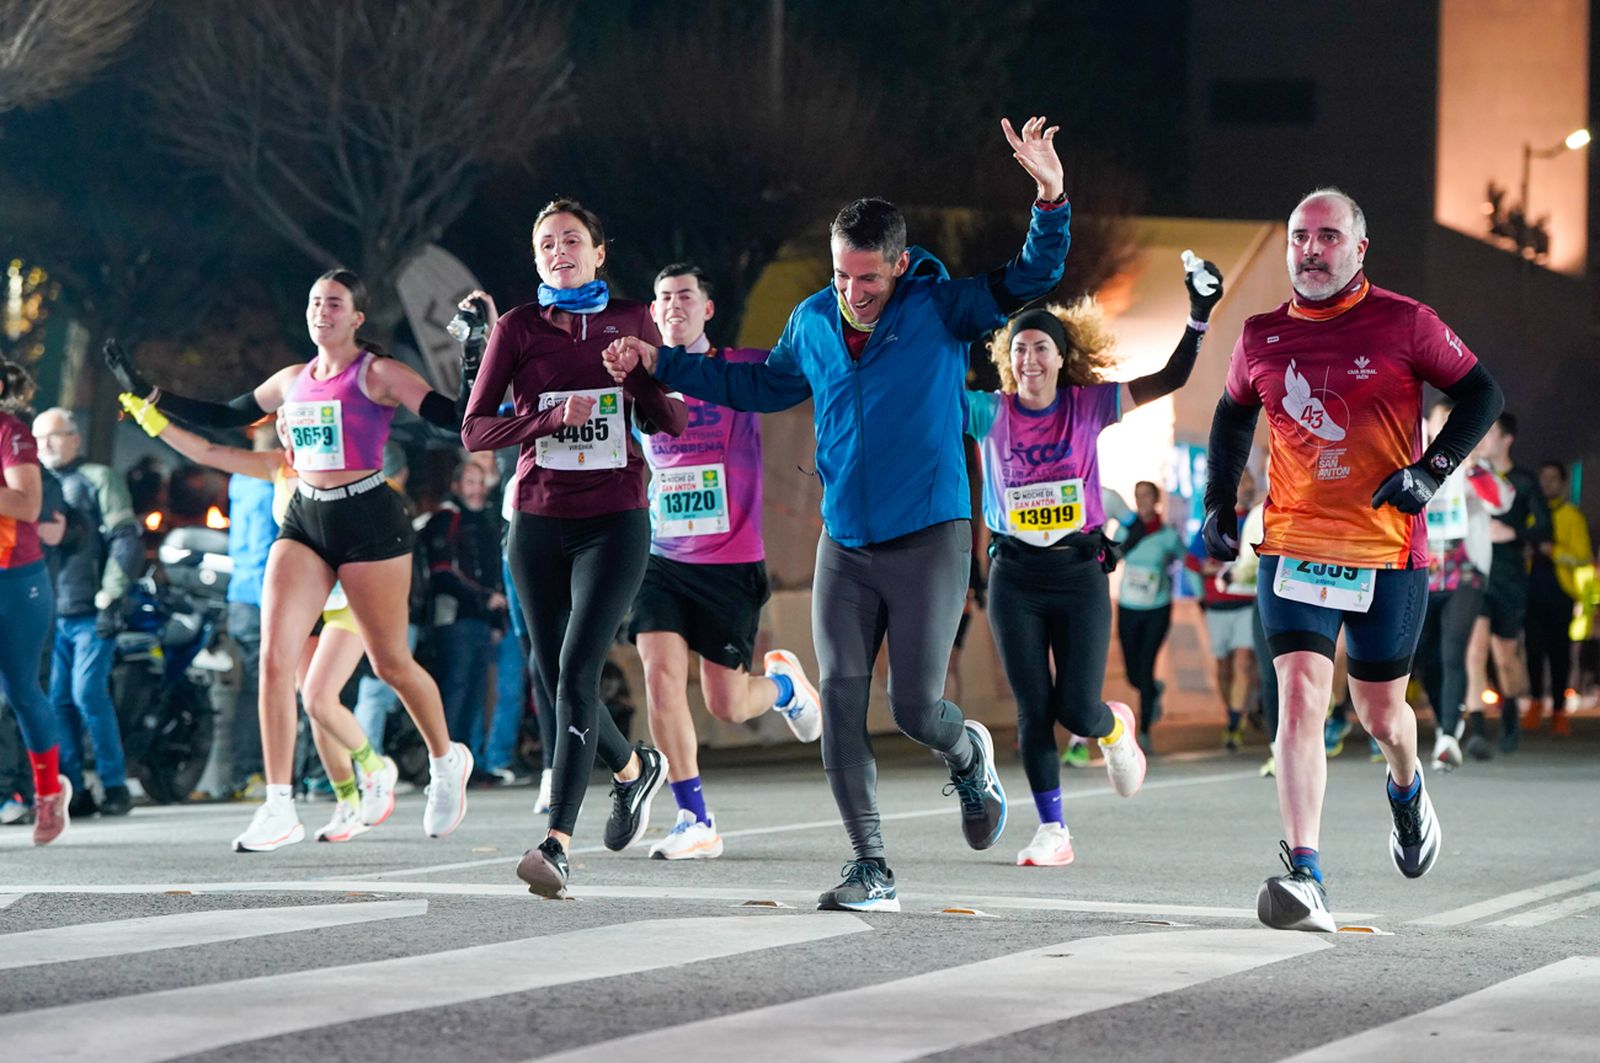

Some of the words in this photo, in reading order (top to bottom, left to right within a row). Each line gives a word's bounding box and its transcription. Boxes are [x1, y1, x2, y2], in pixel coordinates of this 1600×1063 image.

[1301, 405, 1324, 429] 43
[292, 426, 334, 447] 3659
[1319, 459, 1339, 469] SAN
[664, 490, 716, 513] 13720
[1022, 490, 1044, 499] NOCHE
[1046, 489, 1054, 498] DE
[1014, 501, 1029, 509] SAN
[1018, 505, 1074, 524] 13919
